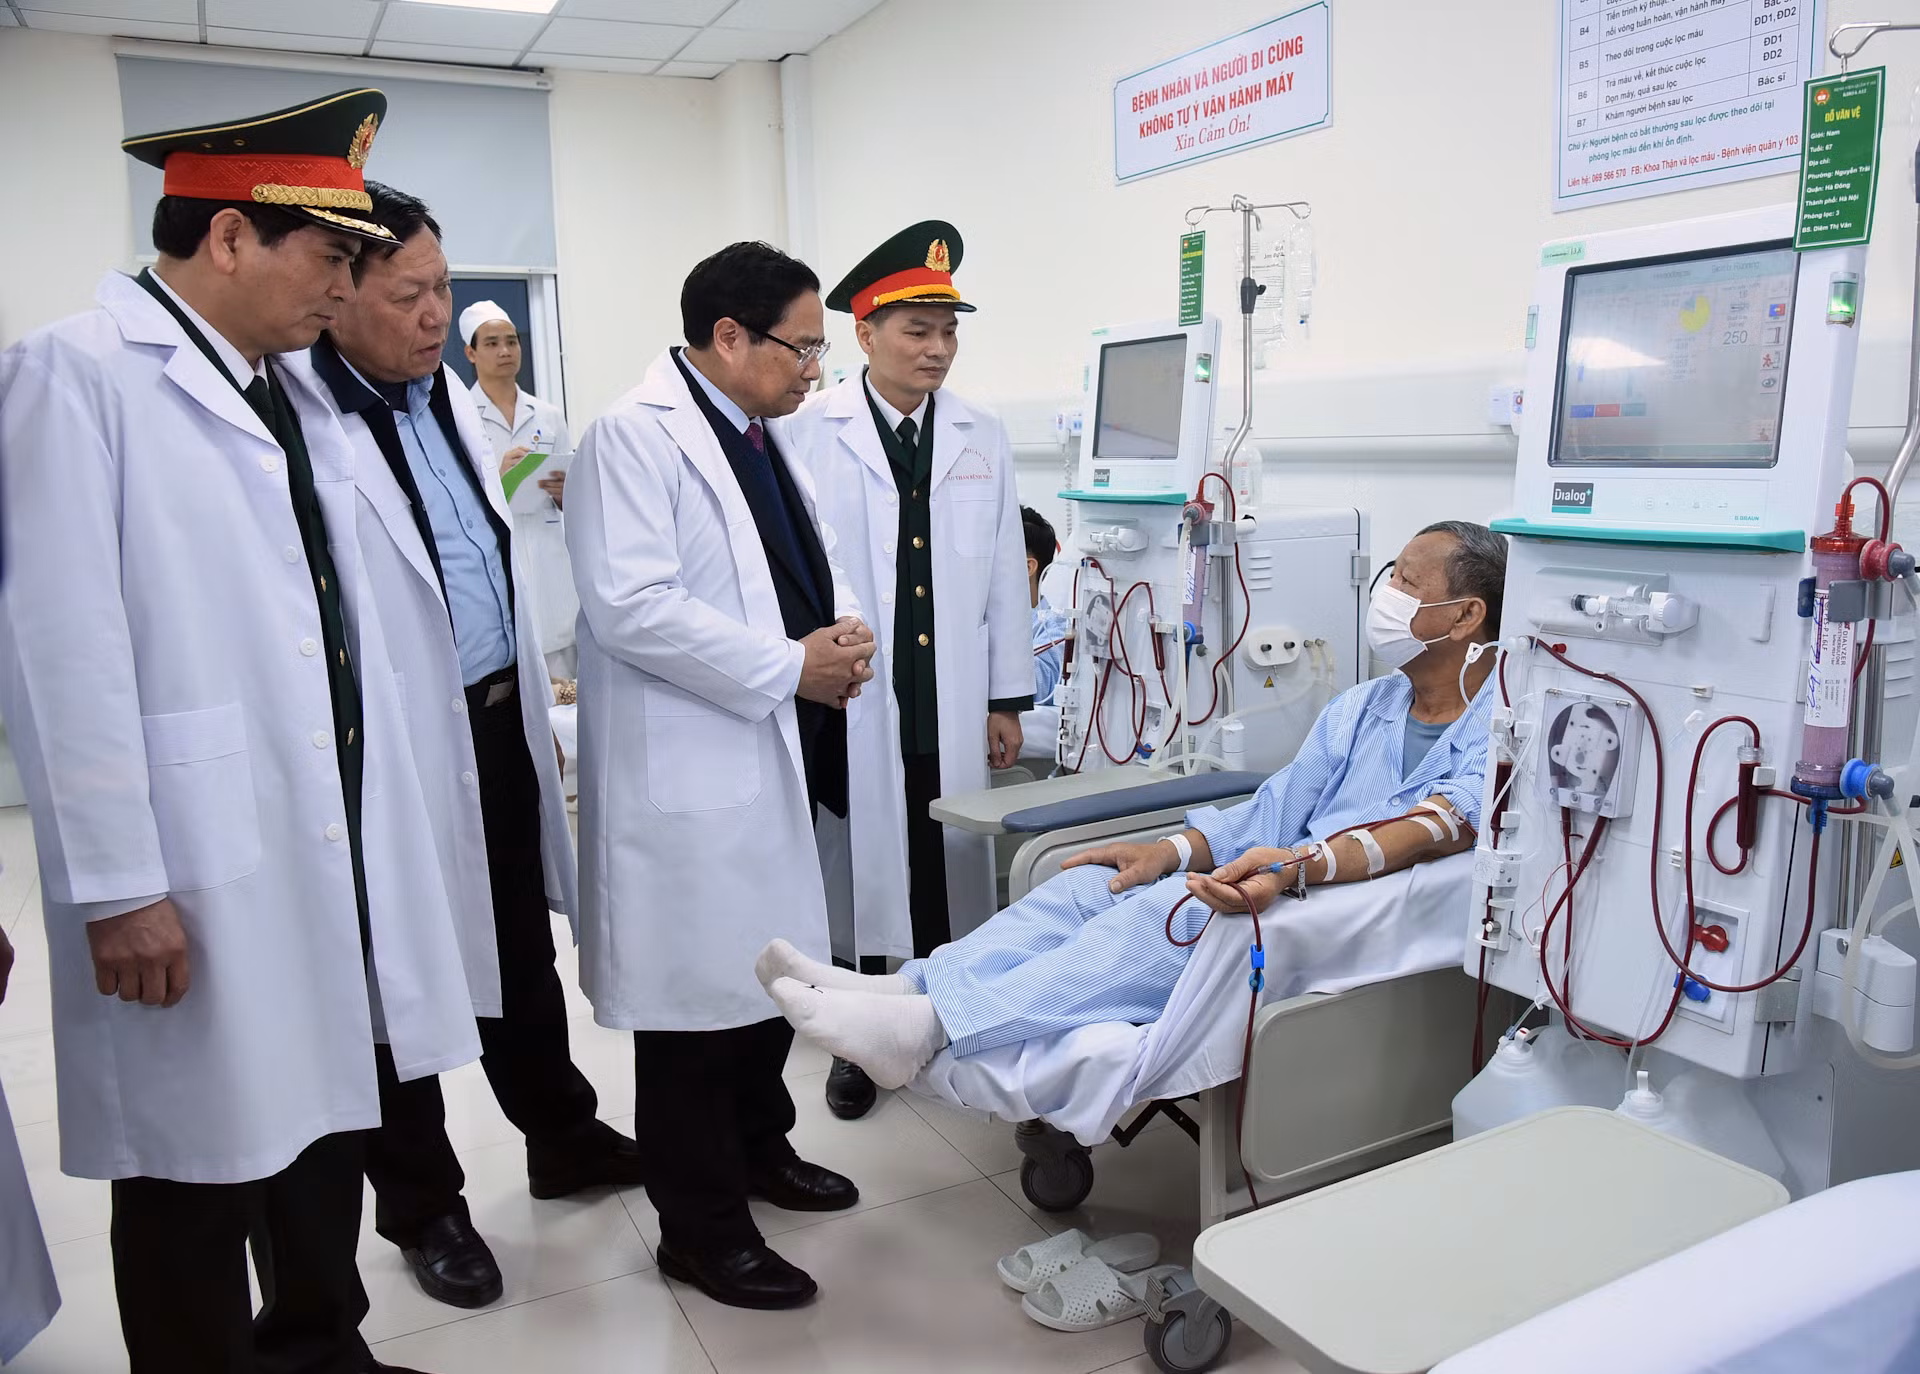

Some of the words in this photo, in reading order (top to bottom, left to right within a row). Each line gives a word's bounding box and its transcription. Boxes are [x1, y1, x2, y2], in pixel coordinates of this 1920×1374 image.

[1622, 6, 1638, 17] trình
[1606, 25, 1616, 37] nối
[1618, 22, 1634, 34] vòng
[1636, 16, 1652, 28] tuần
[1675, 6, 1688, 18] vận
[1690, 1, 1708, 13] hành
[1580, 26, 1589, 36] B4
[1605, 52, 1622, 62] Theo
[1623, 46, 1634, 58] dõi
[1636, 43, 1654, 55] trong
[1656, 37, 1673, 49] cuộc
[1674, 33, 1686, 45] lọc
[1687, 28, 1704, 41] máu
[1764, 34, 1782, 47] ĐD1
[1763, 48, 1782, 62] ĐD2
[1579, 60, 1589, 70] B5
[1132, 90, 1159, 115] BỆNH
[1162, 75, 1192, 104] NHÂN
[1194, 67, 1209, 90] VÀ
[1212, 53, 1248, 85] NGƯỜI
[1251, 50, 1264, 71] ĐI
[1268, 35, 1304, 65] CÙNG
[1606, 80, 1616, 89] Trả
[1618, 76, 1632, 86] máu
[1645, 68, 1656, 78] kết
[1658, 64, 1674, 75] thúc
[1675, 60, 1693, 71] cuộc
[1694, 56, 1706, 66] lọc
[1758, 74, 1775, 87] Bác
[1777, 72, 1786, 82] sĩ
[1578, 90, 1588, 100] B6
[1606, 94, 1619, 105] Dọn
[1638, 85, 1650, 97] quả
[1652, 83, 1664, 92] sau
[1666, 79, 1678, 90] lọc
[1139, 113, 1174, 140] KHÔNG
[1177, 106, 1192, 129] TỰ
[1193, 100, 1201, 121] Ý
[1203, 94, 1226, 123] VẬN
[1229, 82, 1262, 110] HÀNH
[1266, 71, 1294, 99] MÁY
[1605, 112, 1624, 122] Khám
[1626, 104, 1647, 118] người
[1648, 101, 1666, 112] bệnh
[1668, 98, 1680, 107] sau
[1682, 94, 1694, 104] lọc
[1836, 108, 1850, 121] VĂN
[1852, 105, 1860, 119] VỆ
[1568, 142, 1580, 152] Chú
[1590, 135, 1610, 148] Người
[1612, 132, 1628, 144] bệnh
[1629, 129, 1638, 138] có
[1640, 126, 1651, 137] bất
[1652, 120, 1679, 134] thường
[1680, 118, 1694, 128] sau
[1696, 115, 1706, 125] lọc
[1708, 109, 1728, 122] được
[1730, 106, 1748, 116] theo
[1750, 102, 1762, 112] dõi
[1764, 99, 1774, 111] tại
[1576, 118, 1586, 128] B7
[1174, 134, 1195, 152] Xin
[1810, 132, 1825, 140] Giới:
[1588, 152, 1610, 164] phòng
[1610, 149, 1621, 160] lọc
[1622, 146, 1637, 156] máu
[1638, 141, 1652, 152] đến
[1652, 138, 1664, 148] khi
[1666, 136, 1676, 146] ổn
[1676, 132, 1694, 145] định.
[1810, 144, 1824, 152] Tuổi:
[1568, 177, 1580, 188] Liên
[1582, 174, 1592, 186] hệ:
[1592, 172, 1602, 183] 069
[1604, 170, 1614, 181] 566
[1616, 168, 1626, 179] 570
[1631, 165, 1642, 176] FB:
[1644, 162, 1660, 173] Khoa
[1662, 158, 1678, 171] Thận
[1680, 156, 1687, 166] và
[1688, 154, 1699, 166] lọc
[1700, 150, 1716, 162] máu
[1722, 146, 1740, 160] Bệnh
[1742, 143, 1756, 156] viện
[1758, 138, 1776, 154] quân
[1778, 140, 1783, 150] y
[1786, 134, 1799, 146] 103
[1808, 172, 1834, 180] Phường:
[1834, 166, 1858, 176] Nguyễn
[1806, 186, 1824, 194] Quận:
[1834, 182, 1850, 190] Đông
[1824, 196, 1838, 205] phố:
[1848, 194, 1859, 202] Nội
[1804, 212, 1822, 220] Phòng
[1824, 210, 1834, 218] lọc:
[1830, 222, 1840, 230] Thị
[1722, 330, 1748, 346] 250
